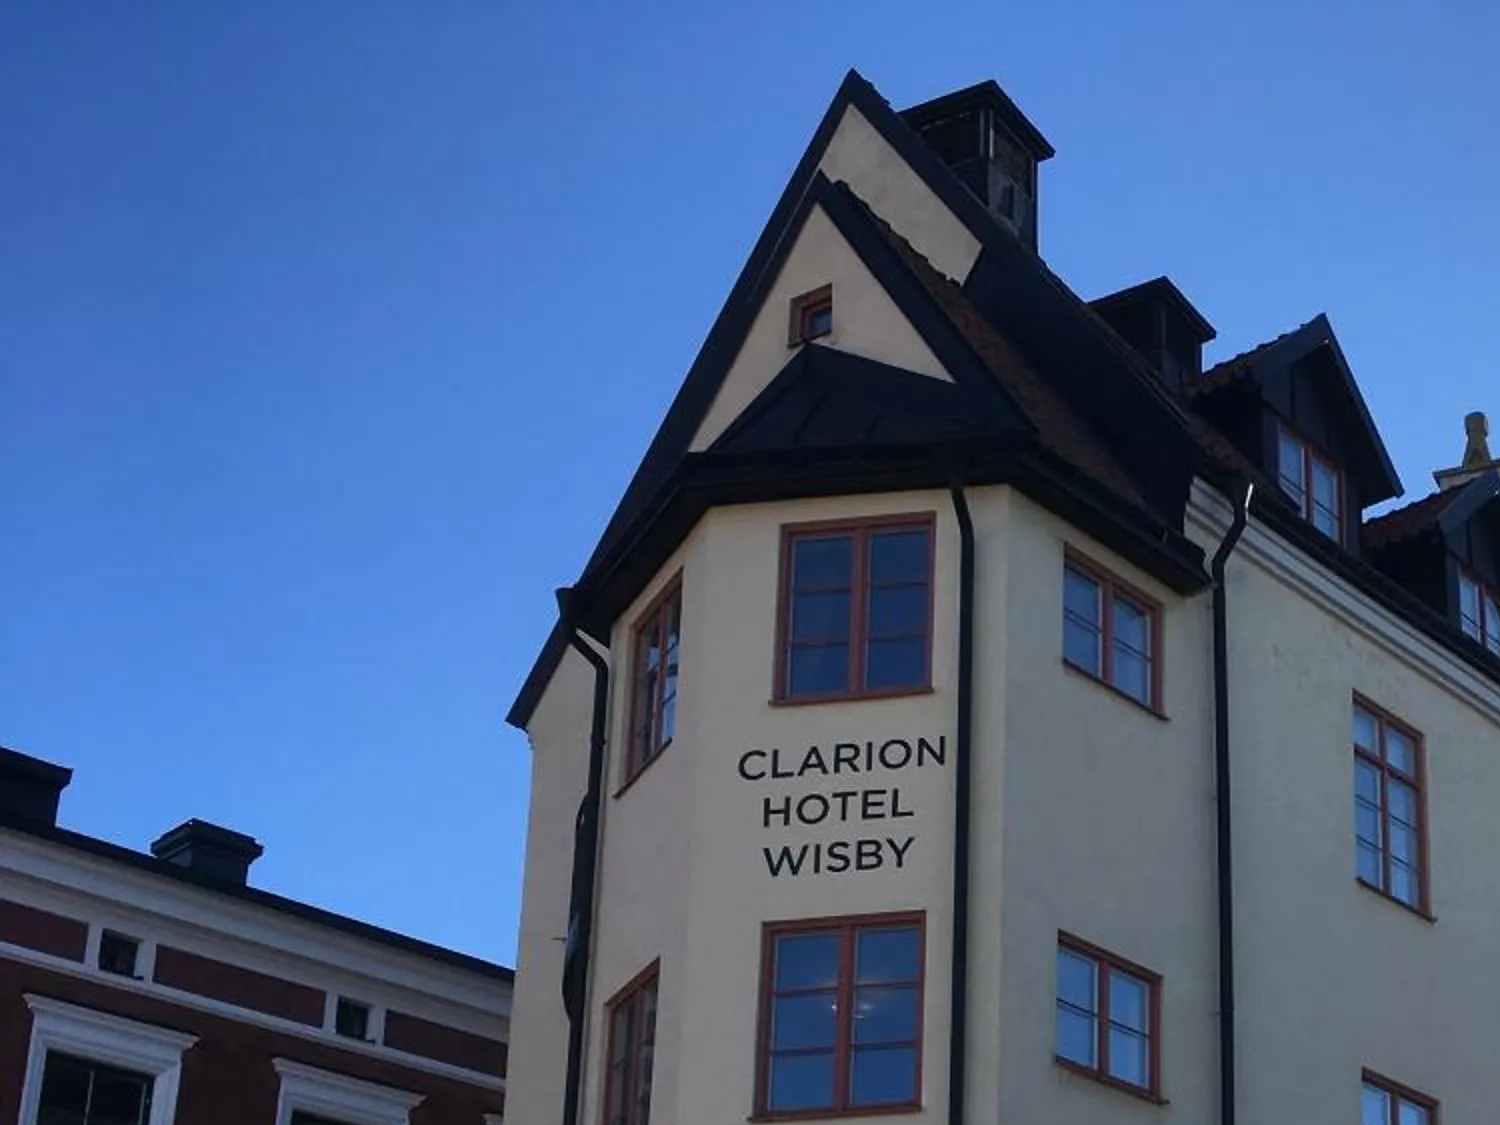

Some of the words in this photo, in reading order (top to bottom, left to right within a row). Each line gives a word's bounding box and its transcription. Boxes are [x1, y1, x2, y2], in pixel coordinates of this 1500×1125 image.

[738, 736, 946, 781] CLARION
[763, 788, 914, 828] HOTEL
[763, 836, 915, 877] WISBY
